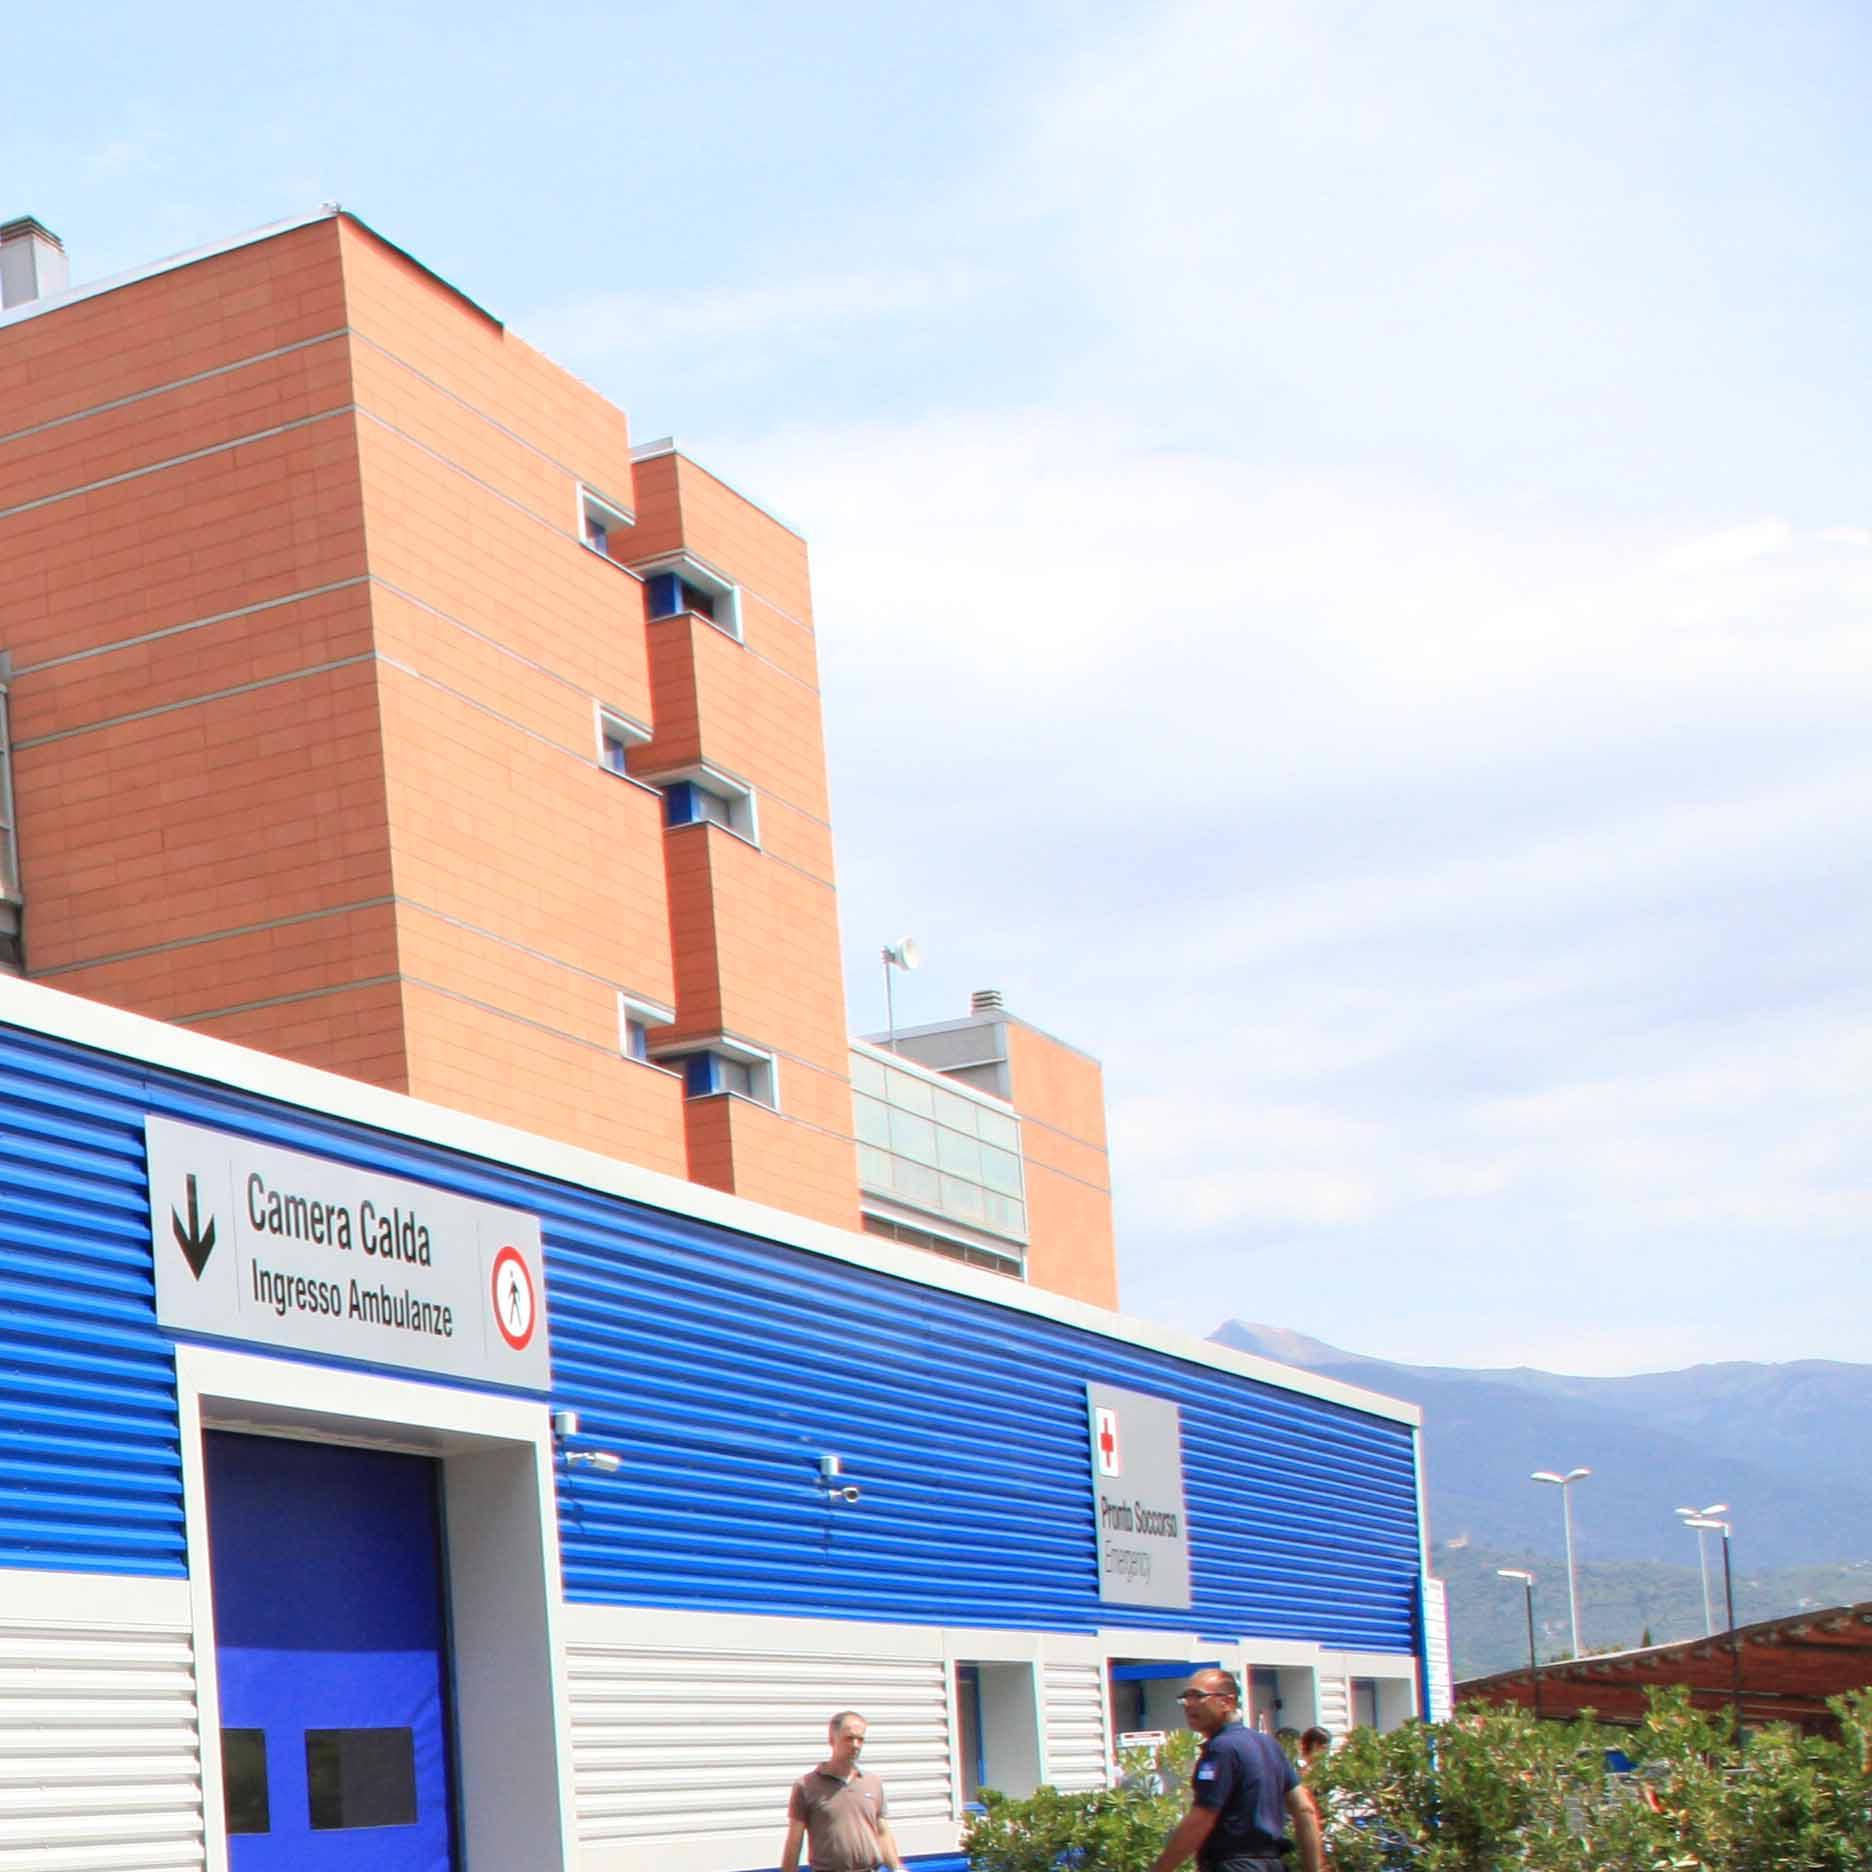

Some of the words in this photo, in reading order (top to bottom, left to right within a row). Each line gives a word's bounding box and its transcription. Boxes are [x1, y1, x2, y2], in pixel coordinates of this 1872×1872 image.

[248, 1172, 352, 1250] Camera
[360, 1200, 432, 1267] Calda
[252, 1258, 342, 1317] Ingresso
[349, 1279, 454, 1338] Ambulanze
[1101, 1496, 1133, 1532] Pronto
[1135, 1501, 1177, 1538] Soccorso
[1104, 1540, 1151, 1585] Emergency
